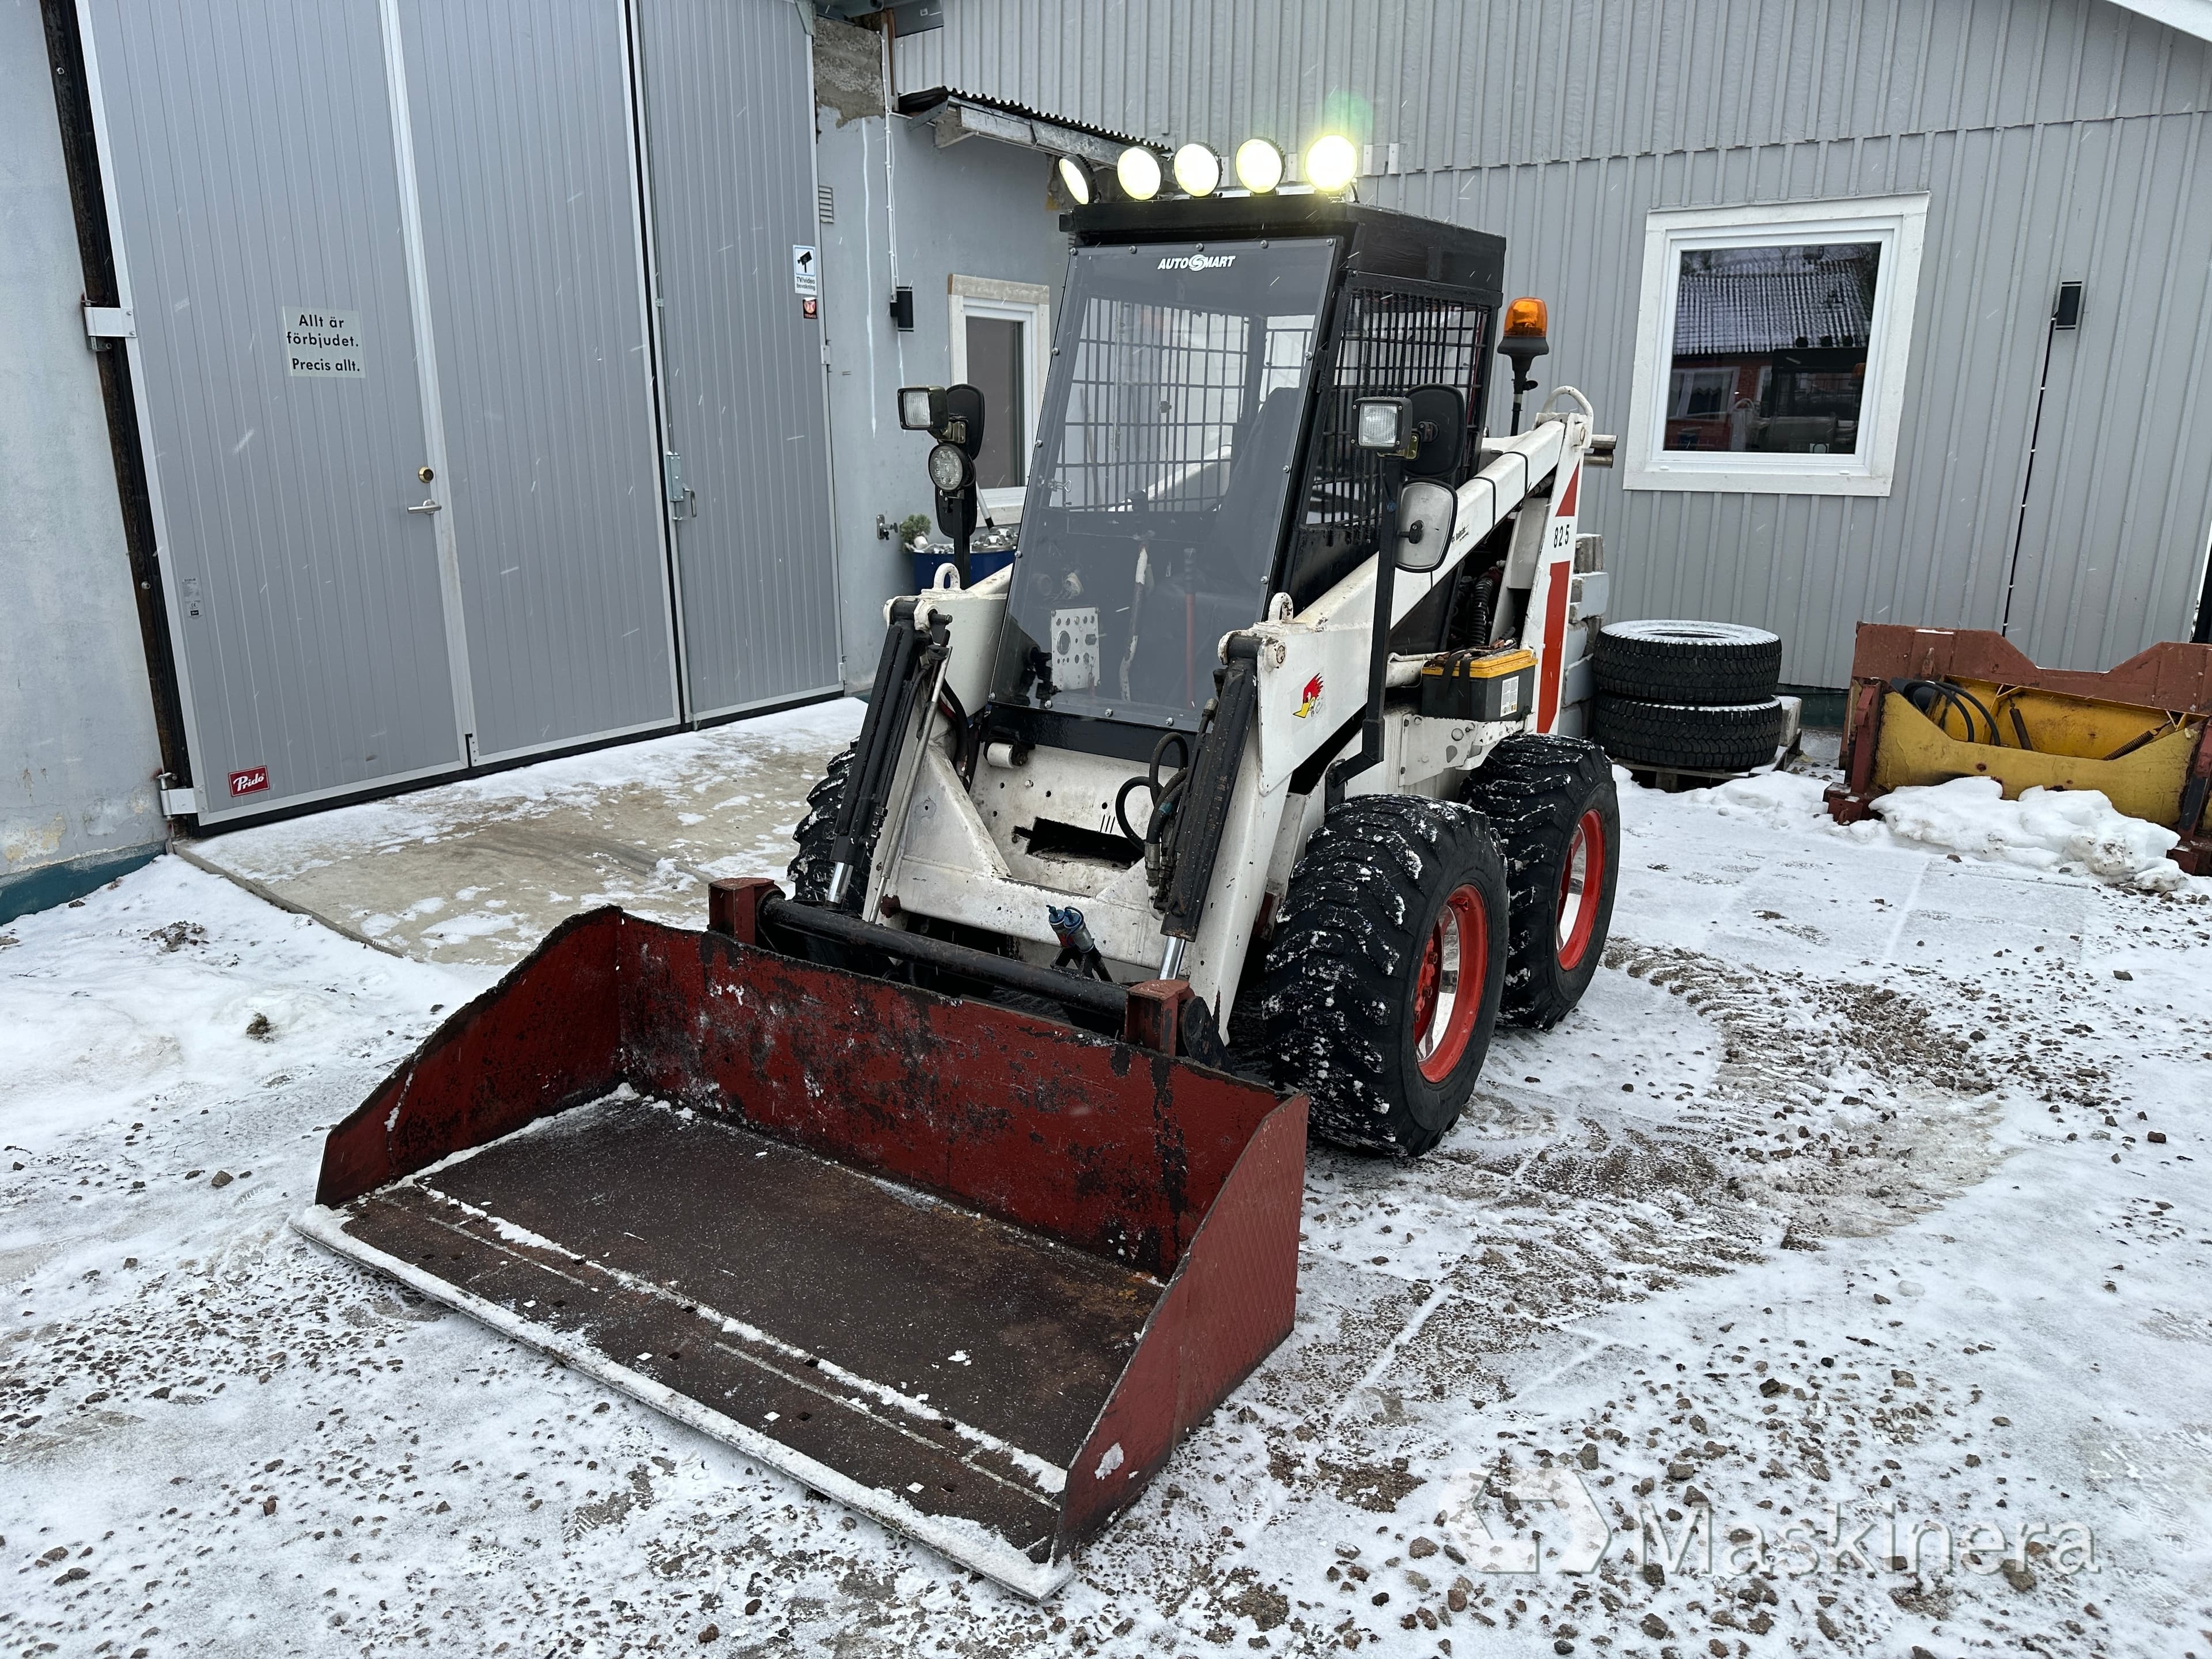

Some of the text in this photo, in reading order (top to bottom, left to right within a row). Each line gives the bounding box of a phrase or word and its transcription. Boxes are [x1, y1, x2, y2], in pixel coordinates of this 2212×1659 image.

[299, 314, 344, 328] Allt är
[287, 331, 359, 349] förbjudet.
[292, 358, 360, 372] Precis allt.
[1554, 524, 1570, 548] 825
[233, 773, 264, 791] Prido
